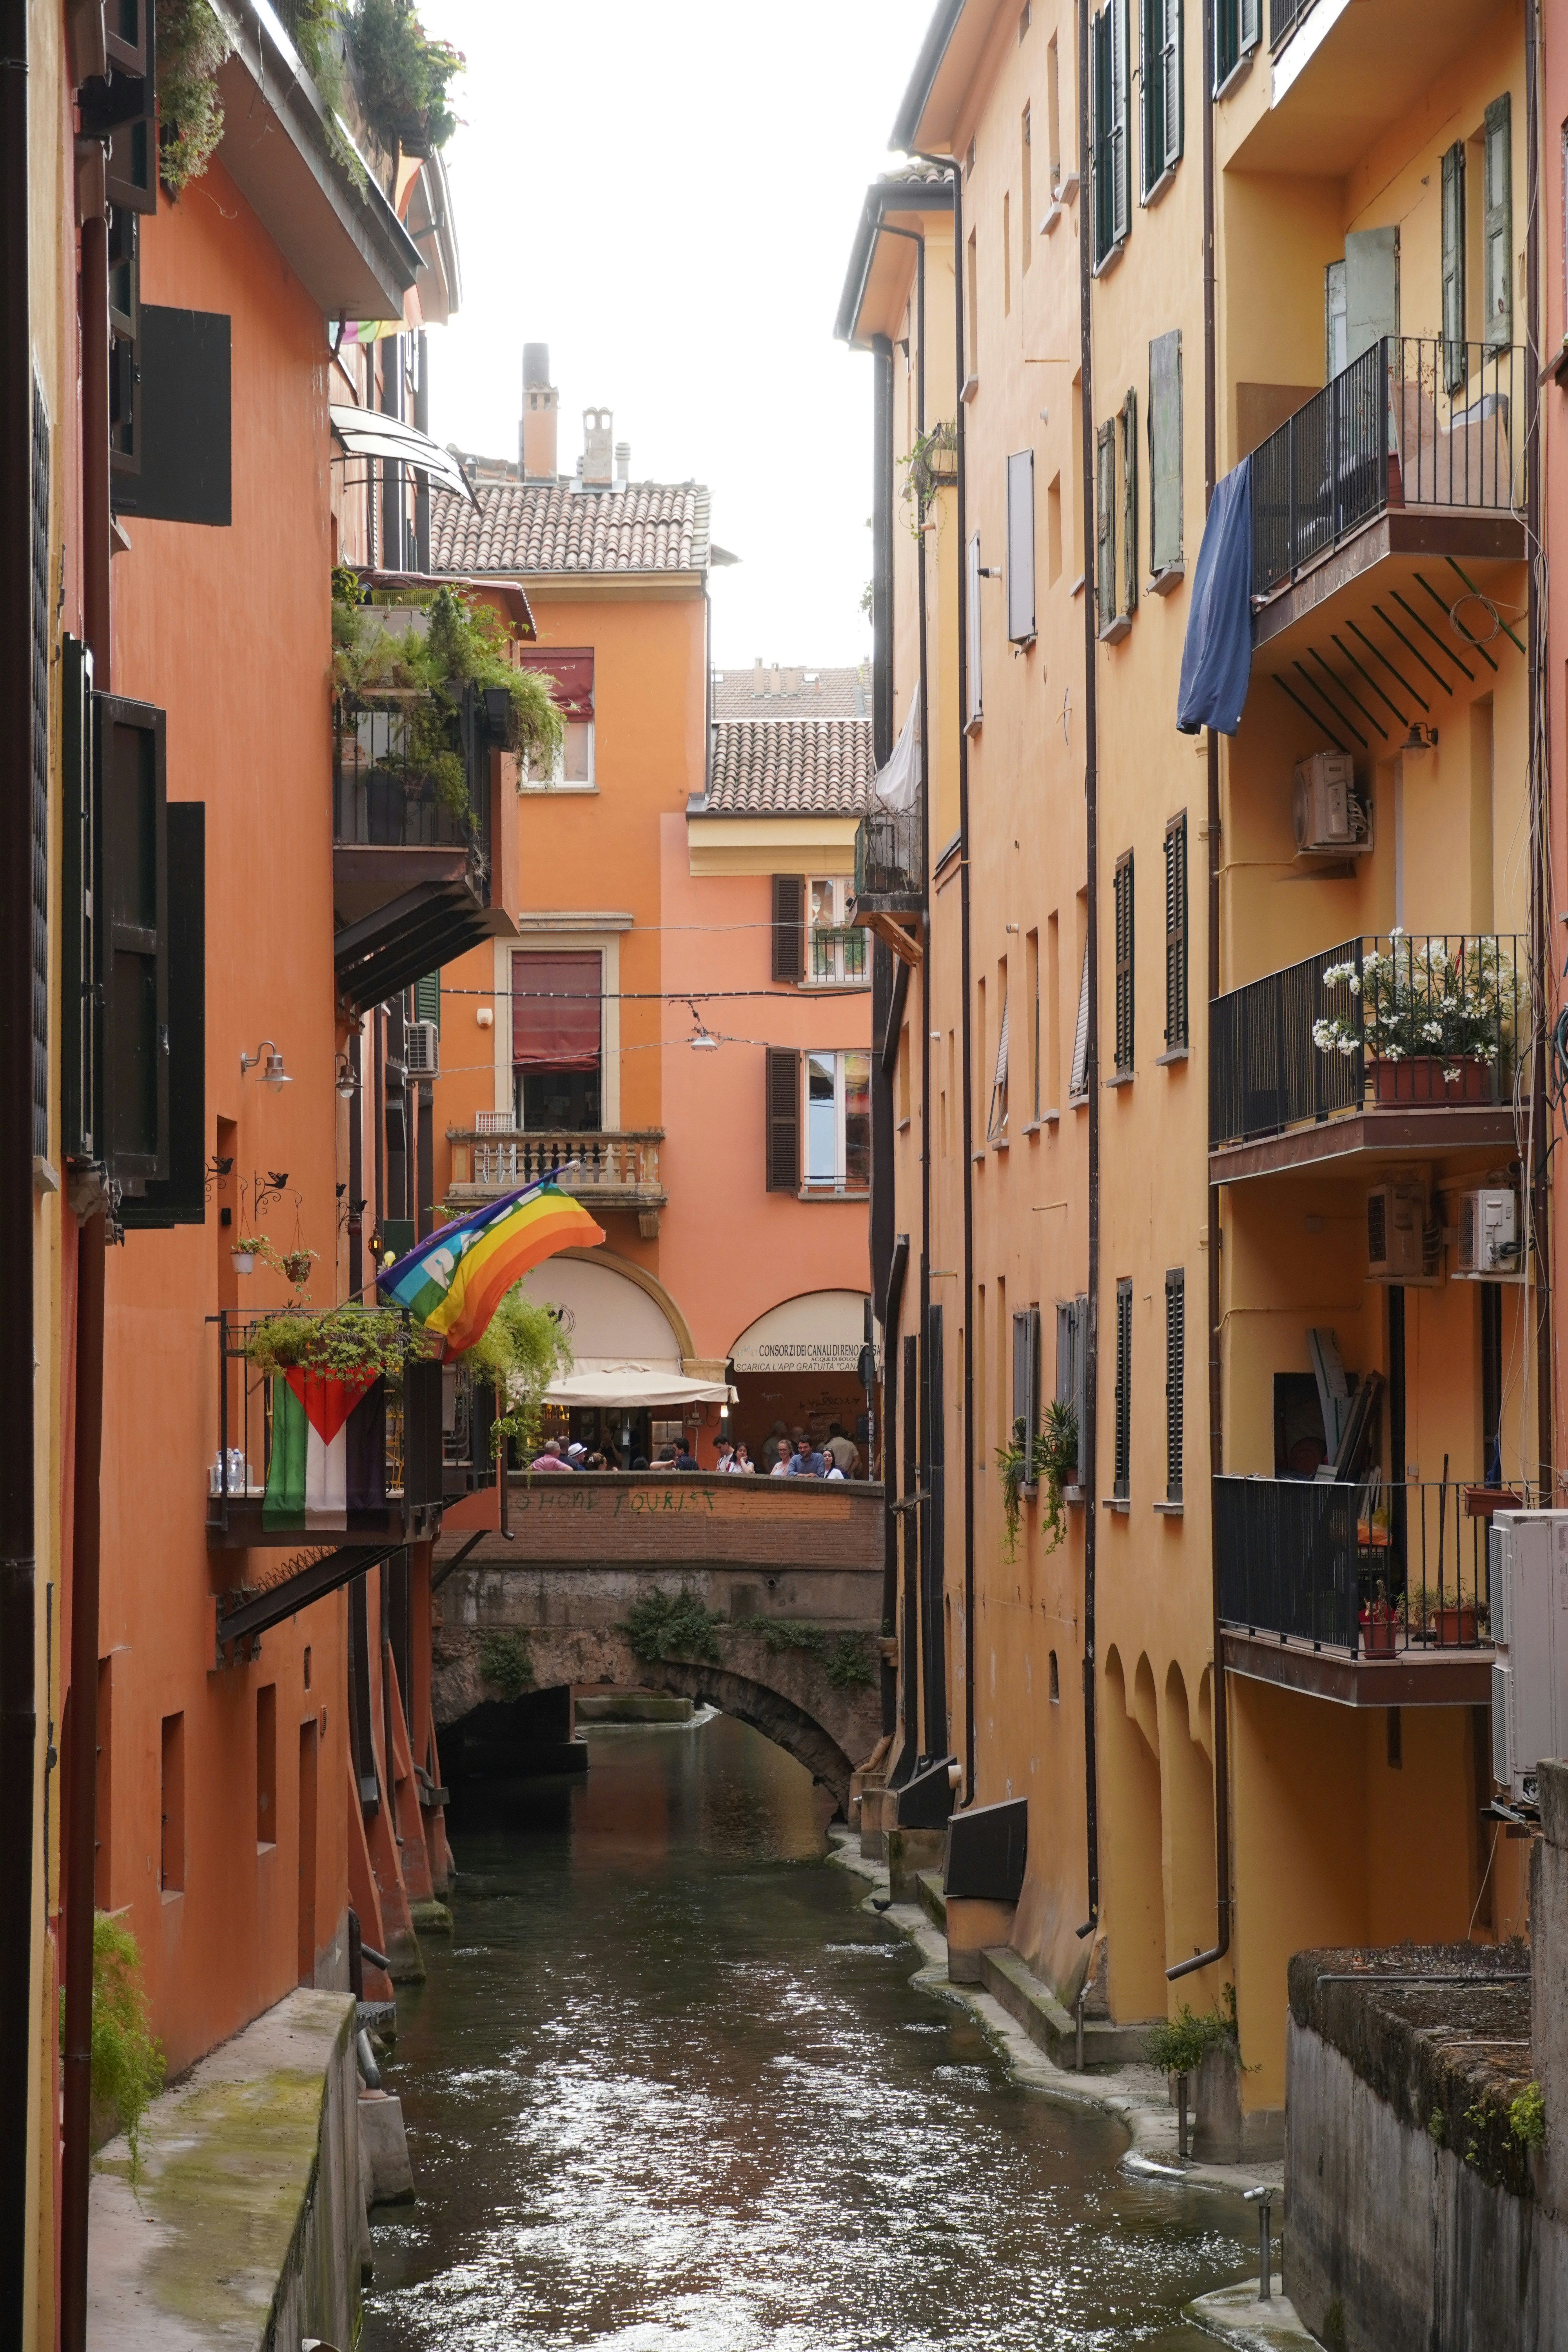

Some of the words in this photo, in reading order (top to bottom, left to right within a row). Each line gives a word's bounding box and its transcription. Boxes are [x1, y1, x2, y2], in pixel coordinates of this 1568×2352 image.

[759, 1345, 795, 1357] CONSORZI
[796, 1345, 806, 1356] DEI
[807, 1345, 831, 1356] CANALI
[833, 1345, 839, 1356] DI
[840, 1345, 859, 1356] RENO
[736, 1363, 770, 1371] SCARICA
[796, 1363, 834, 1371] GRATUITA
[537, 1490, 601, 1511] HOME
[614, 1490, 716, 1518] TOURIST
